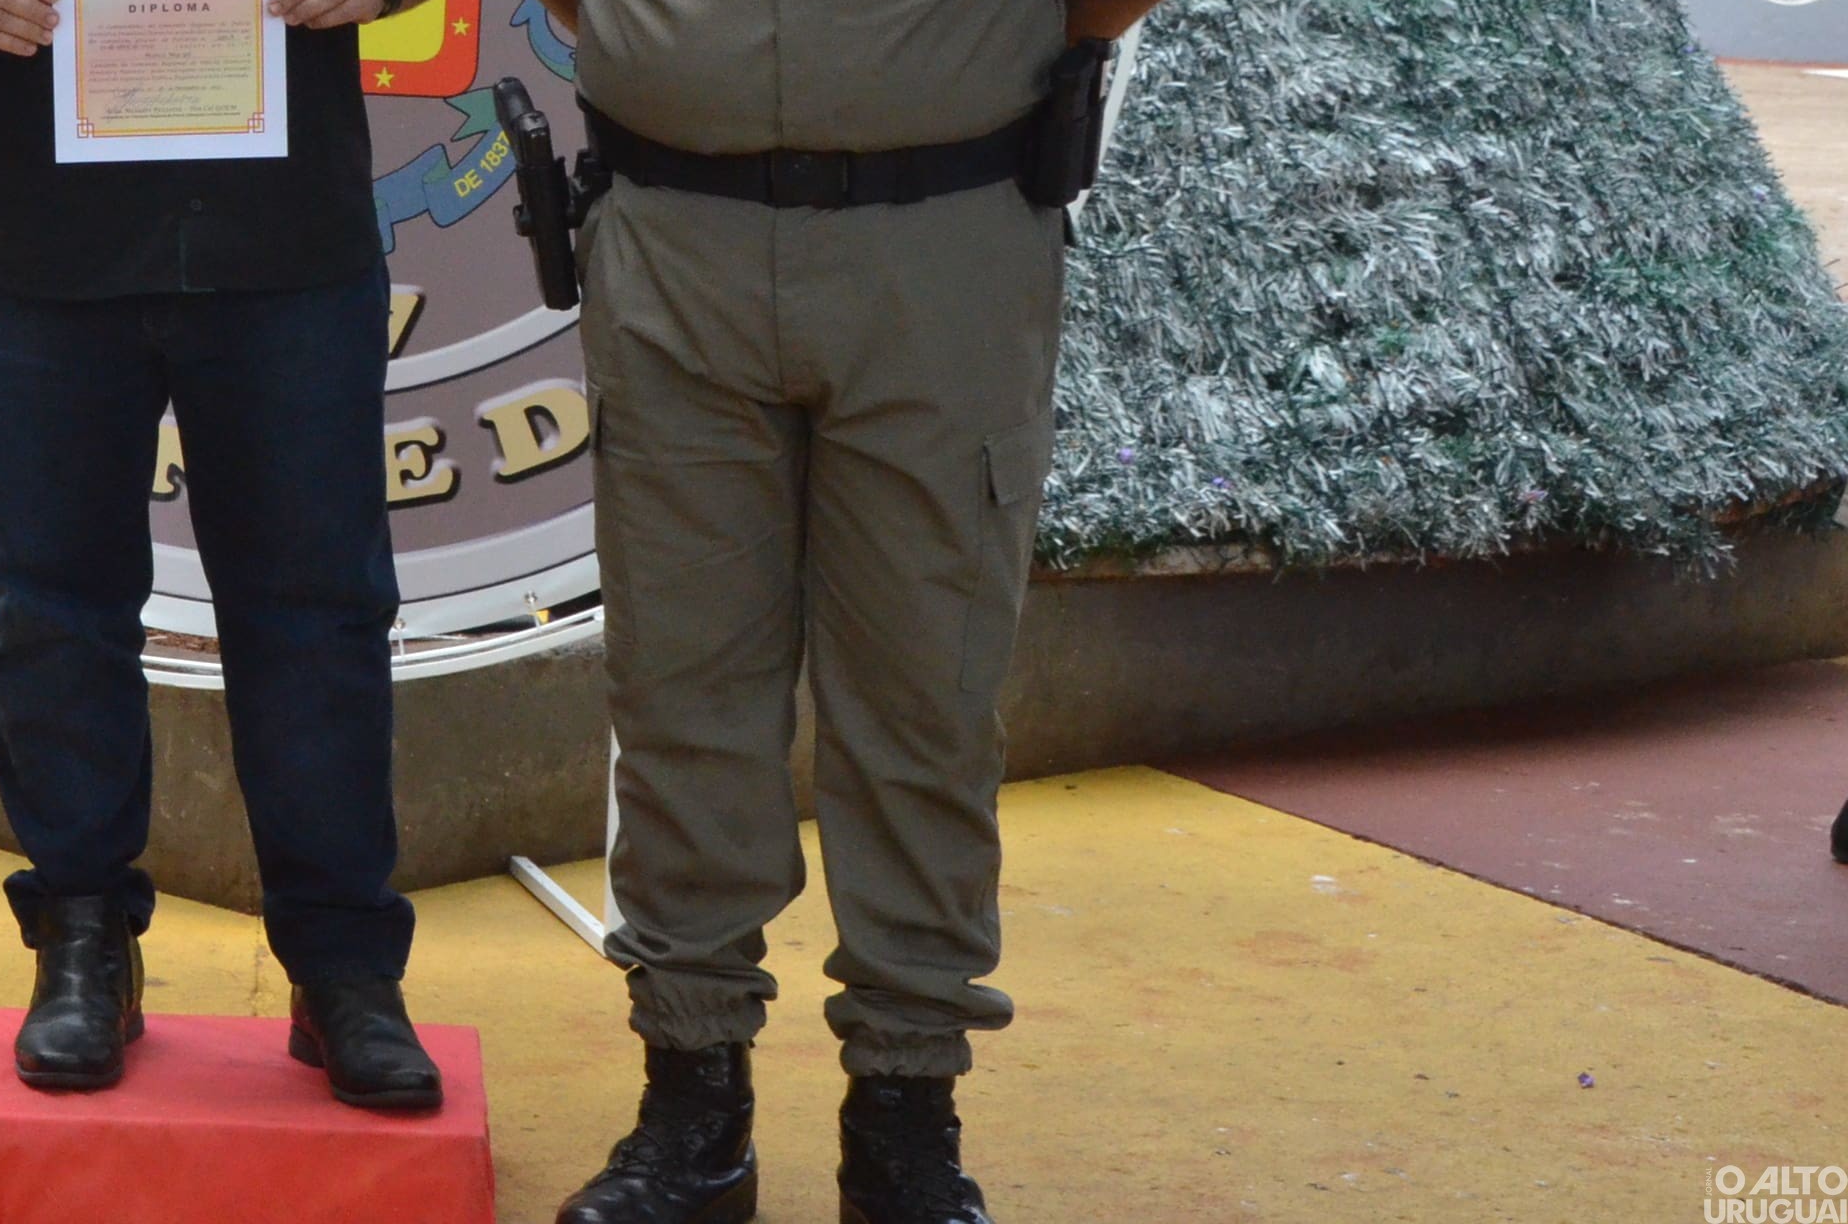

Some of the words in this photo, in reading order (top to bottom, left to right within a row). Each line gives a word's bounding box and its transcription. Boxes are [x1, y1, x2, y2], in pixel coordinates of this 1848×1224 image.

[128, 2, 211, 14] DIPLOMA
[454, 169, 483, 198] DE
[479, 129, 510, 173] 1837
